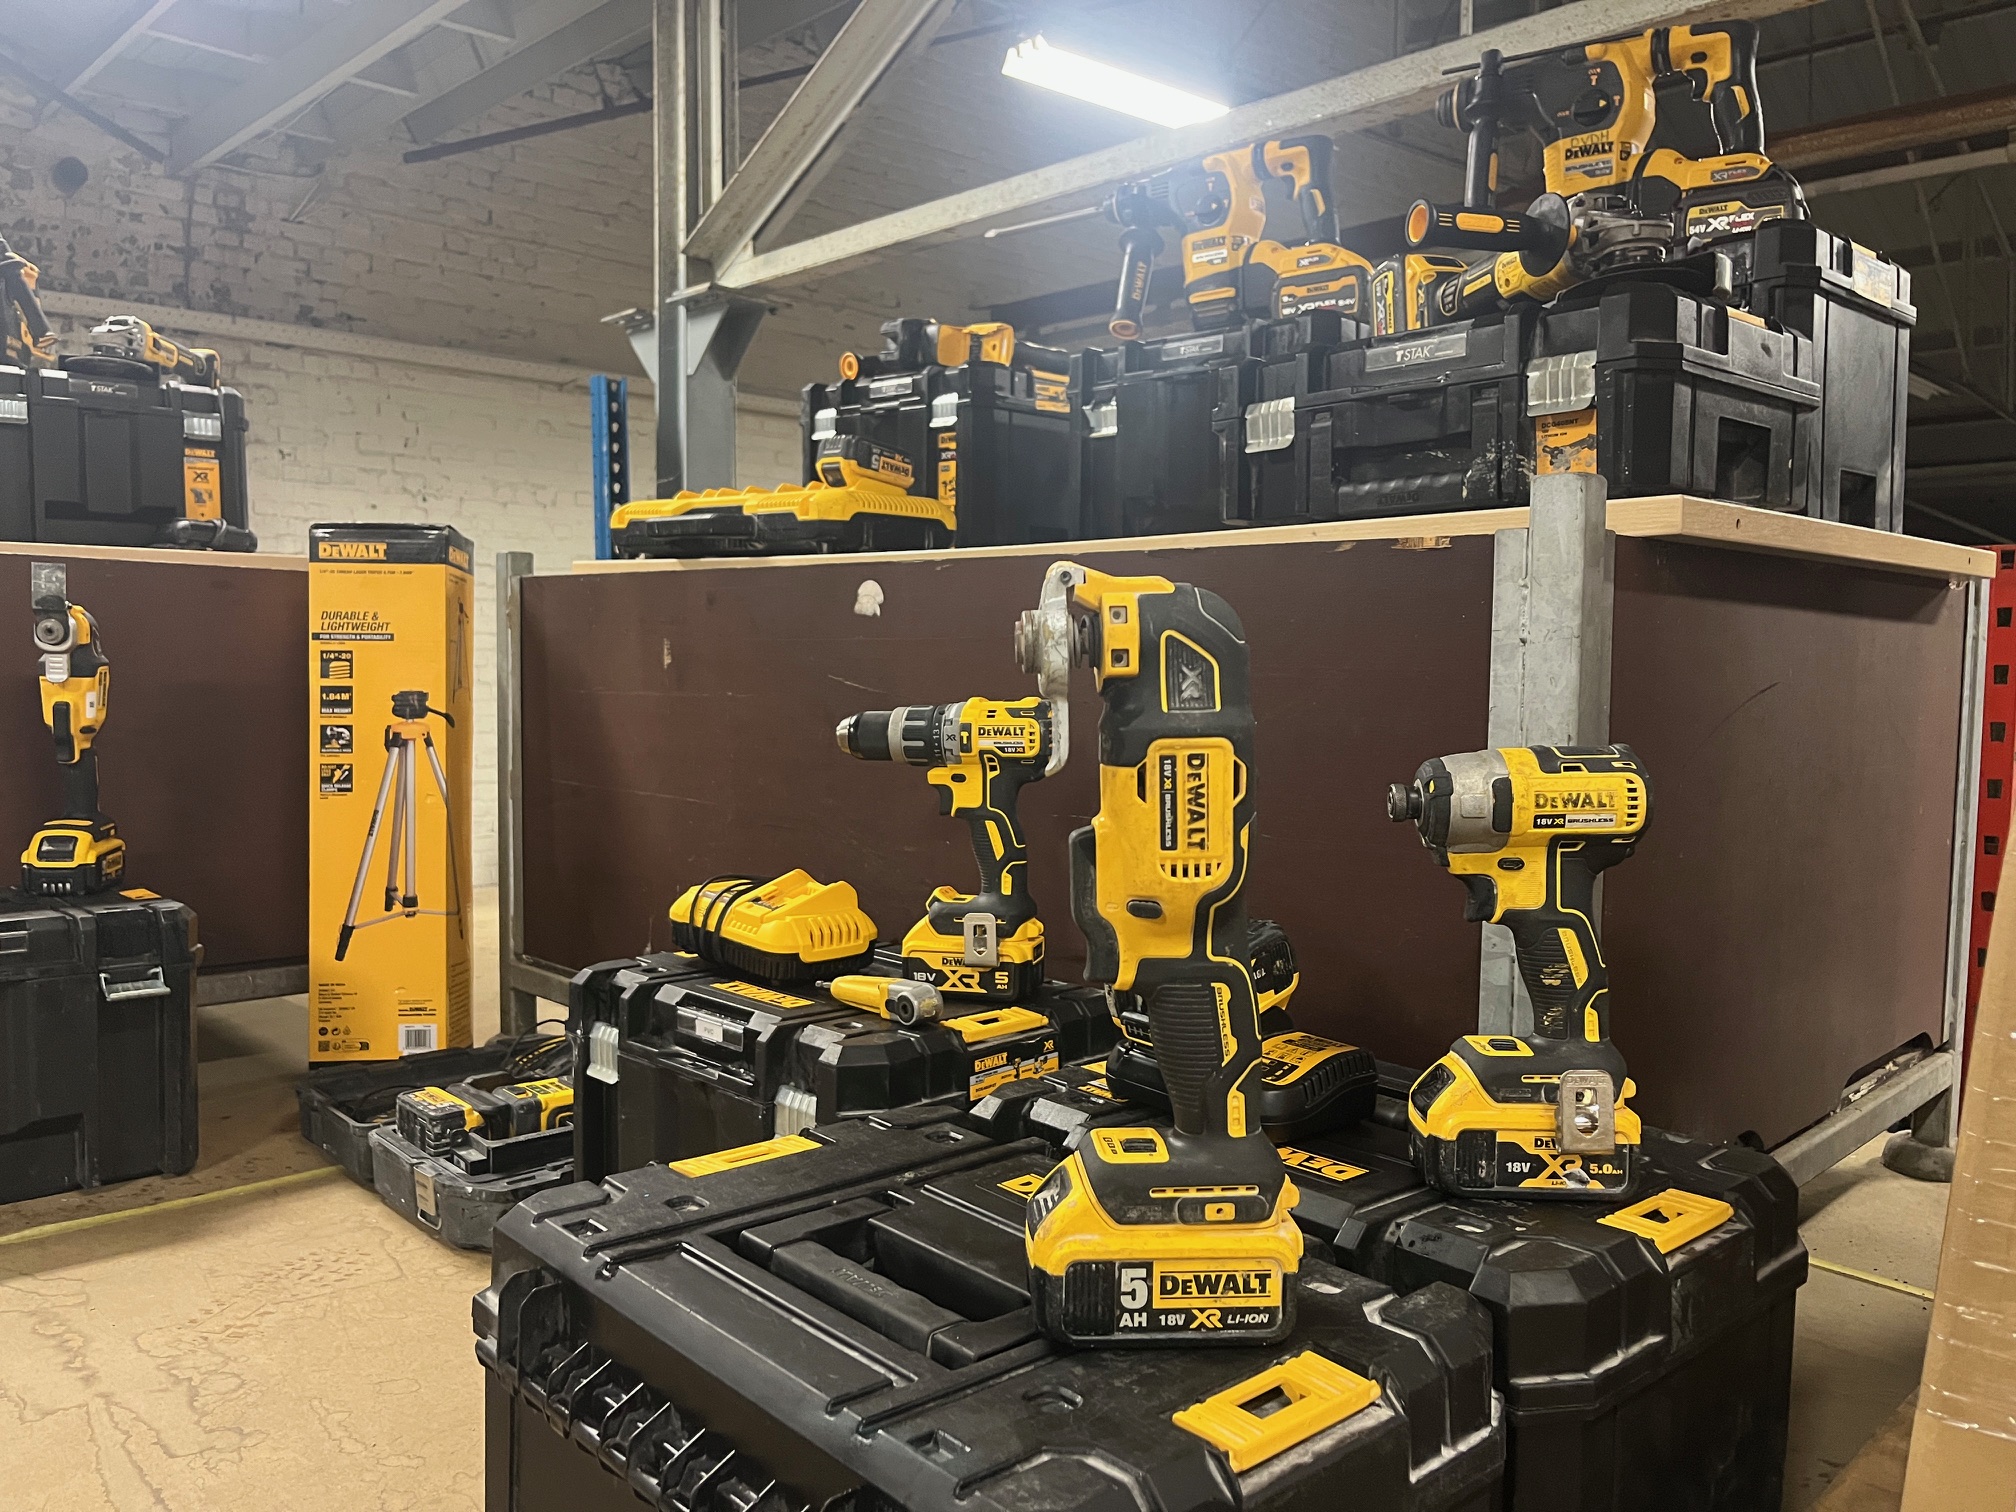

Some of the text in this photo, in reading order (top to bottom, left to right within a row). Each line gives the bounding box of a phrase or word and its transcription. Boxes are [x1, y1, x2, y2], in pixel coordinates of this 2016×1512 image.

[1565, 142, 1614, 160] DEWALT
[1699, 204, 1728, 215] DEWALT
[1706, 216, 1731, 233] XR
[880, 460, 911, 477] DEWALT
[319, 542, 387, 560] DEWALT
[321, 610, 379, 621] DURABLE &
[320, 621, 391, 632] LIGHTWEIGHT
[932, 729, 940, 739] 13
[945, 733, 957, 742] XR
[978, 726, 1026, 737] DEWALT
[1163, 759, 1174, 848] 18V XR BRUSHLESS
[1186, 753, 1206, 851] DEWALT
[1534, 792, 1616, 809] DEWALT
[1536, 818, 1553, 826] 18V
[941, 957, 966, 967] DEW
[913, 966, 1009, 993] 18V XR 5
[1216, 986, 1231, 1058] BRUSHLESS
[1043, 1040, 1055, 1051] XR
[974, 1052, 1008, 1073] DEWALT
[1277, 1147, 1369, 1182] DEW
[1506, 1161, 1531, 1173] 18V
[1120, 1267, 1149, 1310] 5
[1160, 1272, 1272, 1296] DEWALT
[1119, 1312, 1148, 1328] AH
[1159, 1308, 1270, 1330] 18V XR LI-ION
